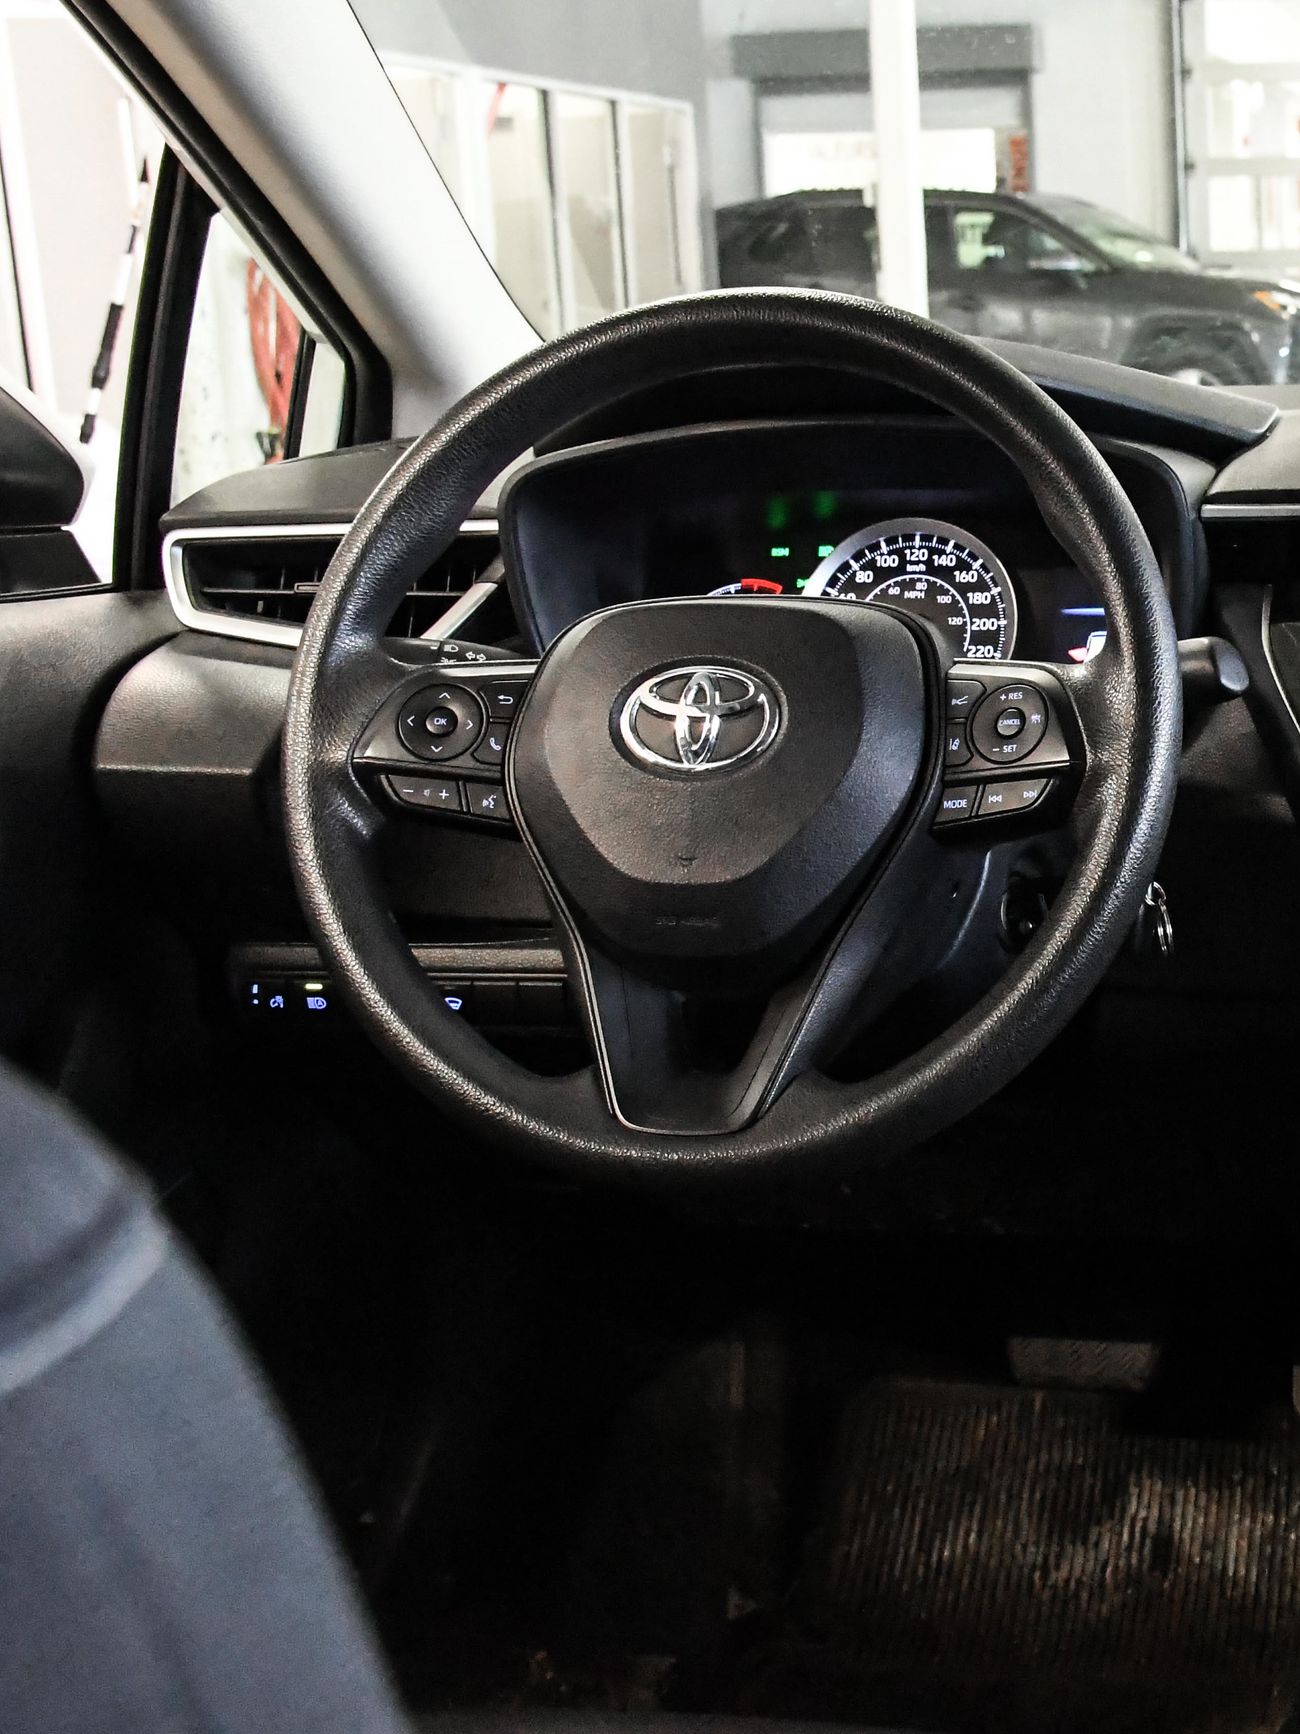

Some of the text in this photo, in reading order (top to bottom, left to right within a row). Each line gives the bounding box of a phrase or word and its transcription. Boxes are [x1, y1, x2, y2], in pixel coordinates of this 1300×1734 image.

[904, 549, 928, 561] 120
[875, 555, 899, 567] 100
[932, 555, 956, 567] 140
[906, 563, 926, 573] km/h
[855, 570, 873, 583] 80
[954, 570, 978, 583] 160
[888, 586, 900, 596] 60
[915, 582, 928, 590] 80
[904, 591, 925, 600] MPH
[936, 595, 952, 604] 100
[967, 592, 991, 605] 180
[947, 617, 963, 626] 120
[971, 618, 998, 631] 200
[967, 645, 994, 658] 220
[434, 717, 448, 726] OK
[999, 718, 1020, 726] CANCEL
[943, 799, 967, 809] MODE
